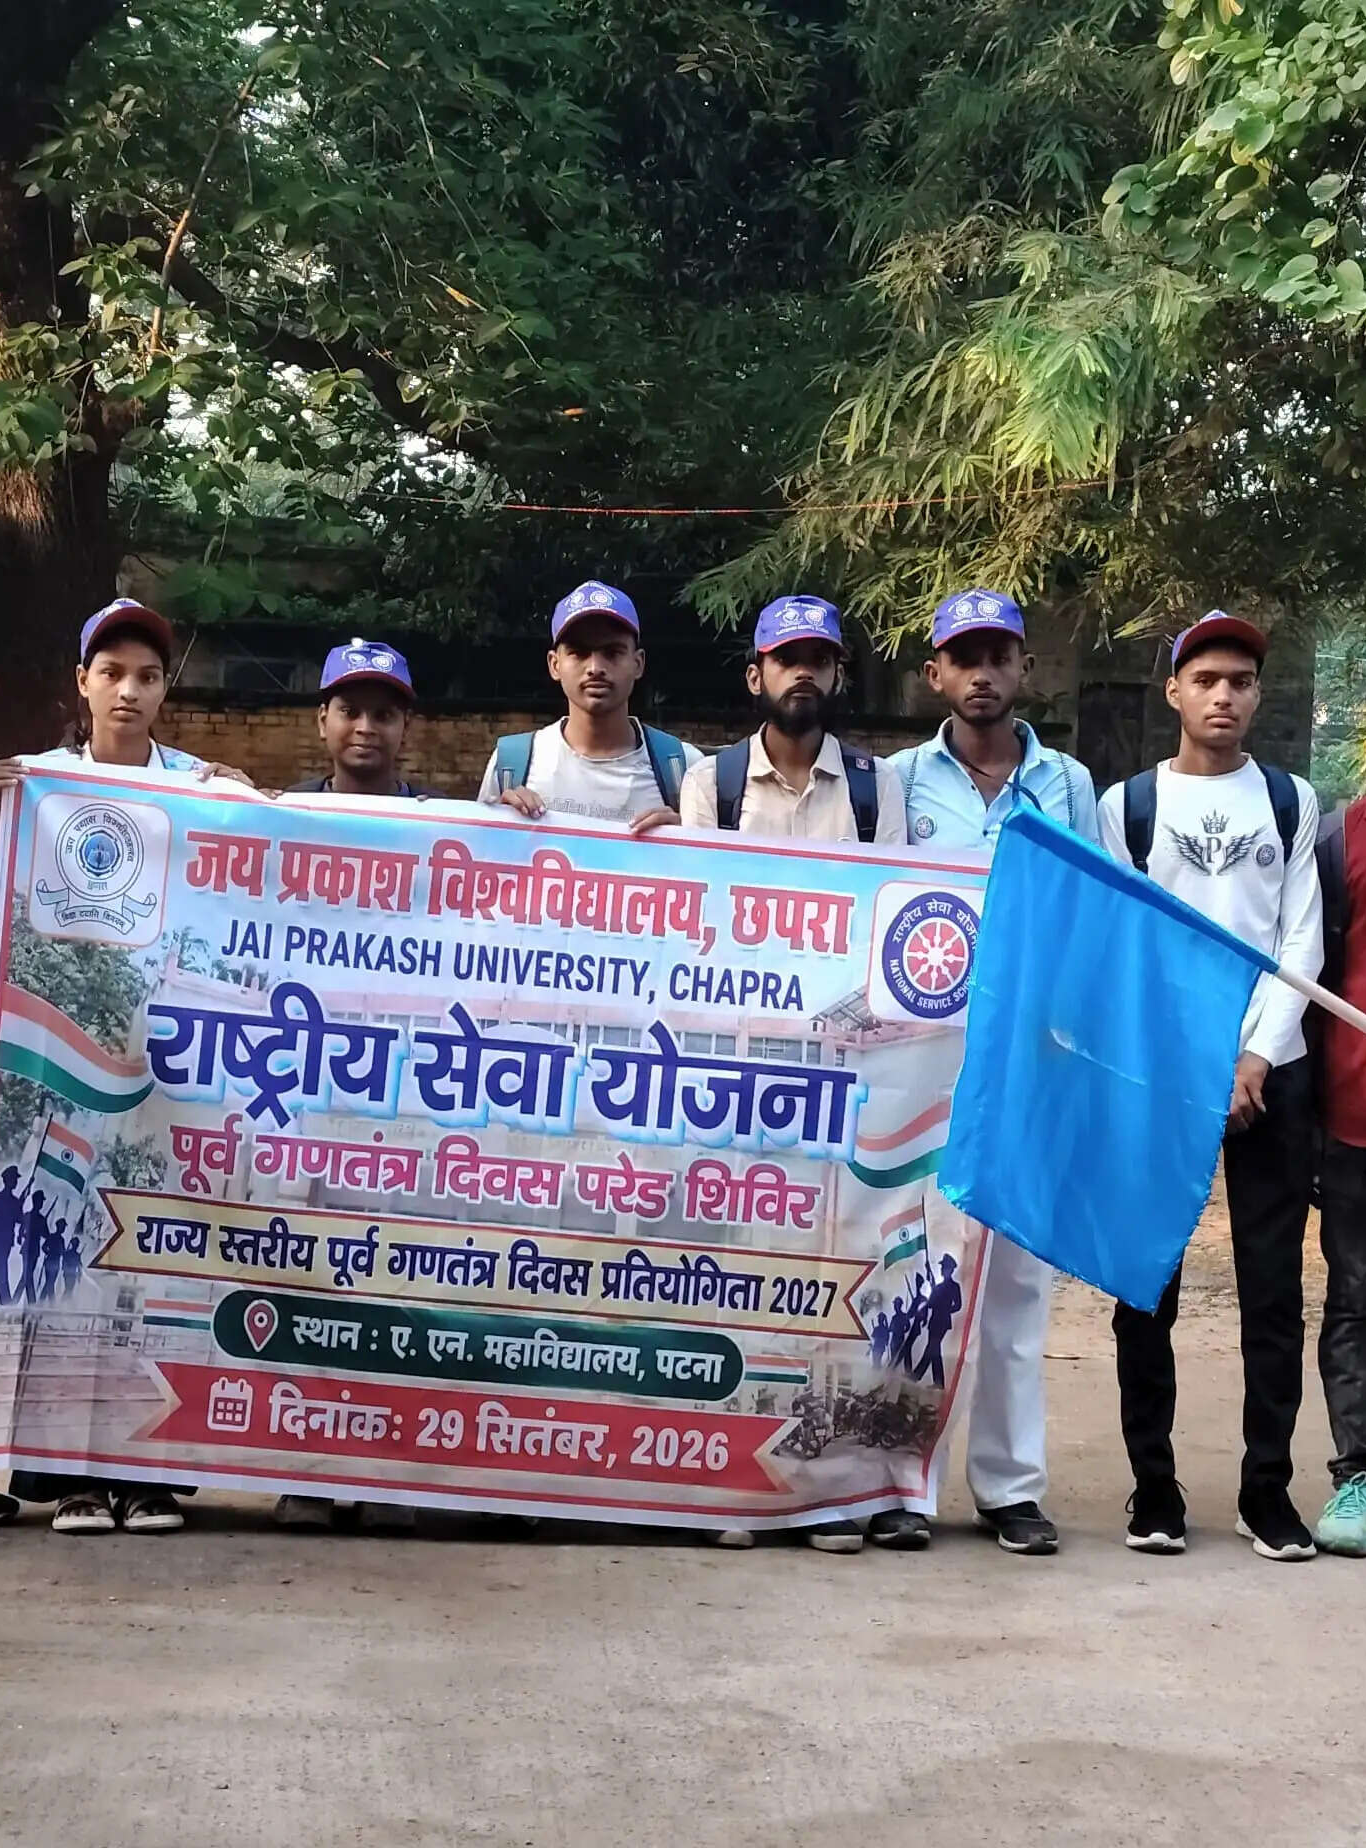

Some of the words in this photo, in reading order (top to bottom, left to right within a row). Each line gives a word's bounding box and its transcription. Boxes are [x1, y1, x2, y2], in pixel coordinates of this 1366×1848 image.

[186, 830, 271, 896] जय
[276, 840, 420, 912] प्रकाश
[427, 838, 717, 955] विश्वविद्यालय,
[729, 885, 855, 954] छपरा
[221, 919, 272, 960] JAI
[284, 925, 442, 977] PRAKASH
[453, 942, 656, 1005] UNIVERSITY,
[669, 963, 804, 1011] CHAPRA
[889, 959, 918, 1003] NATIONAL
[916, 996, 954, 1010] SERVICE
[146, 981, 399, 1129] राष्ट्रीय
[413, 1001, 575, 1117] सेवा
[591, 1019, 857, 1144] योजना
[169, 1112, 243, 1194] पूर्व
[254, 1131, 423, 1193] गणतंत्र
[433, 1134, 565, 1206] दिवस
[575, 1151, 674, 1219] परेड
[685, 1158, 821, 1230] शिविर
[136, 1215, 211, 1259] राज्य
[218, 1216, 318, 1272] स्तरीय
[326, 1225, 379, 1288] पूर्व
[387, 1236, 500, 1290] गणतंत्र
[507, 1239, 594, 1297] दिवस
[600, 1249, 765, 1312] प्रतियोगिता
[768, 1276, 838, 1318] 2027
[292, 1314, 362, 1351] स्थान
[390, 1325, 417, 1360] ए.
[427, 1328, 474, 1363] एन.
[484, 1327, 646, 1383] महाविद्यालय,
[655, 1348, 725, 1384] पटना
[416, 1407, 464, 1450] 29
[475, 1401, 616, 1469] सितंबर,
[629, 1426, 730, 1472] 2026
